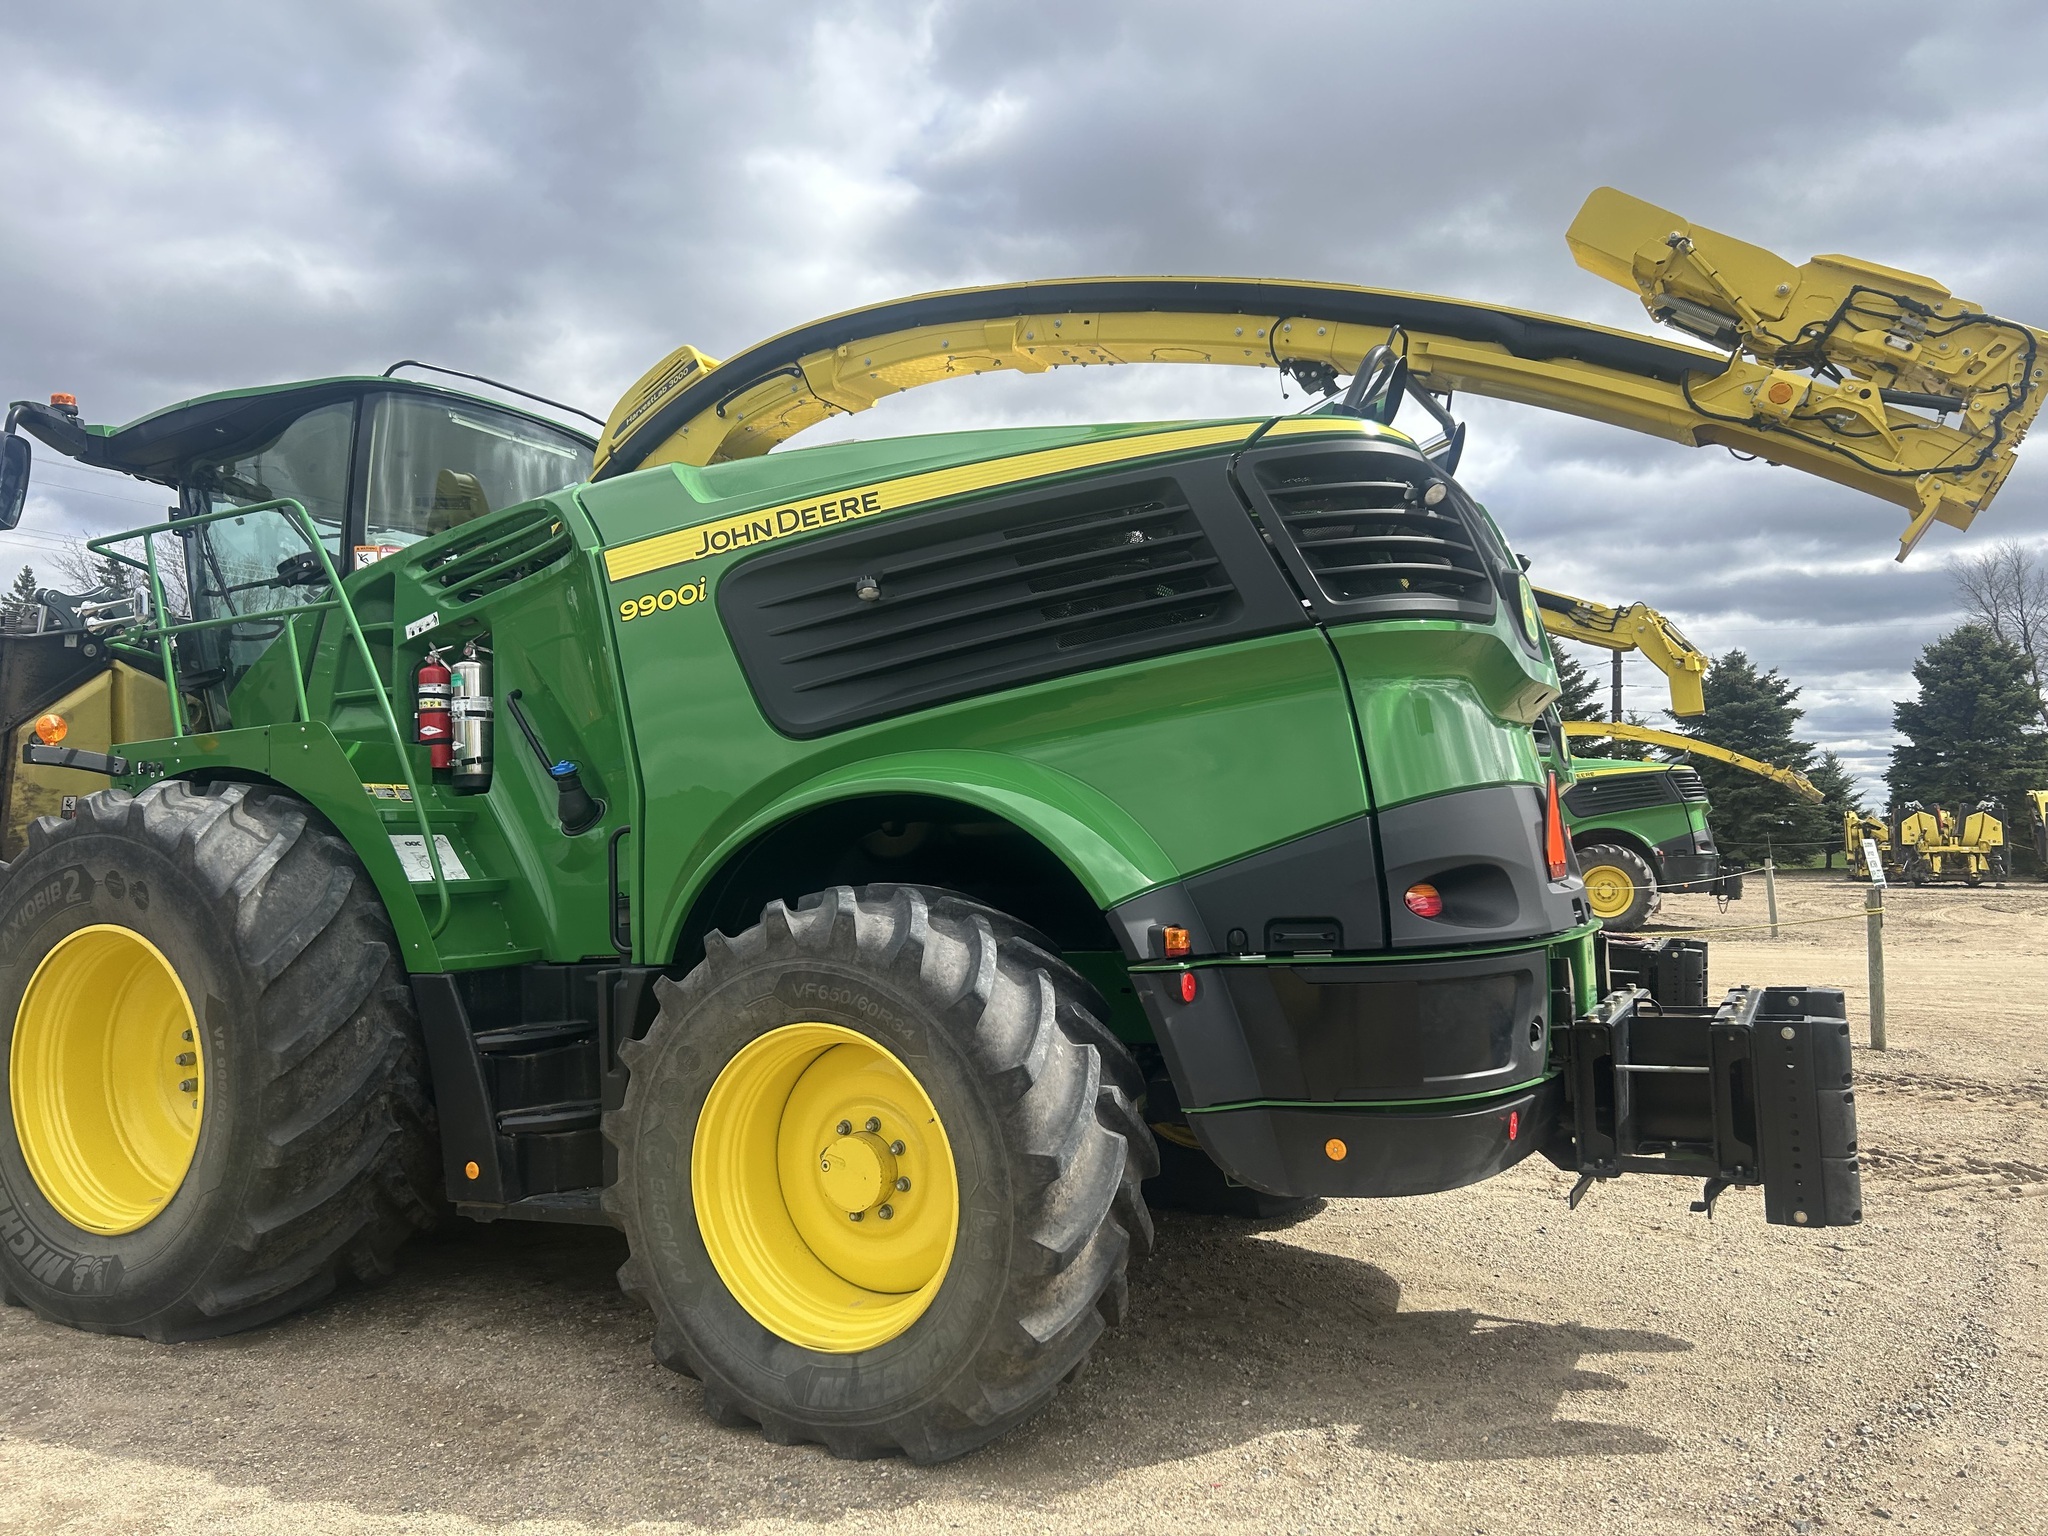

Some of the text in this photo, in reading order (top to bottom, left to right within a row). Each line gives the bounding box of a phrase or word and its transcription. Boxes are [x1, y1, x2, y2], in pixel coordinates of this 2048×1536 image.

[626, 367, 689, 426] HarvestLab 3000
[695, 491, 881, 556] JOHN DEERE
[619, 575, 708, 623] 9900i
[1, 869, 82, 954] AXIOBIB 2
